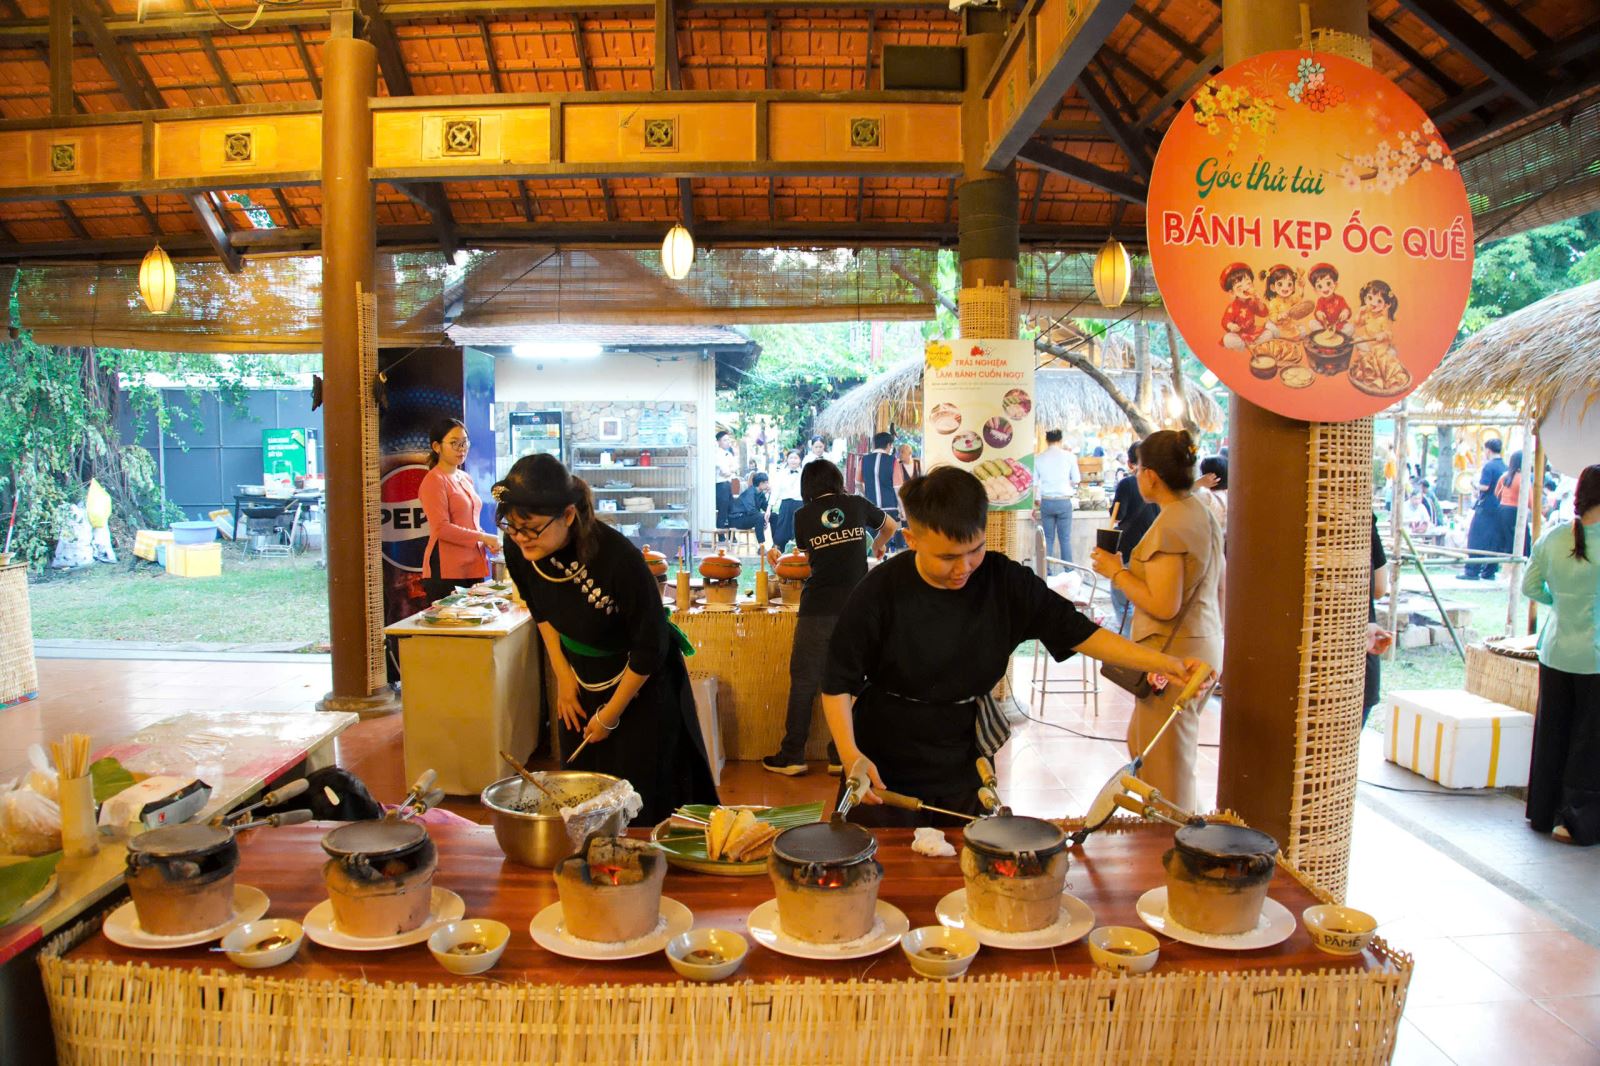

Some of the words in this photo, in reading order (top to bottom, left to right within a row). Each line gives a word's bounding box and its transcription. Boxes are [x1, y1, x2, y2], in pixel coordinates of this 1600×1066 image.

[1195, 157, 1242, 199] Góc
[1246, 161, 1287, 192] thử
[1291, 166, 1325, 195] tài
[1163, 205, 1262, 247] BÁNH
[1273, 219, 1333, 258] KẸP
[1342, 209, 1393, 255] ỐC
[1402, 216, 1466, 260] QUẾ
[955, 369, 976, 378] BÁNH
[809, 527, 865, 547] TOPCLEVER
